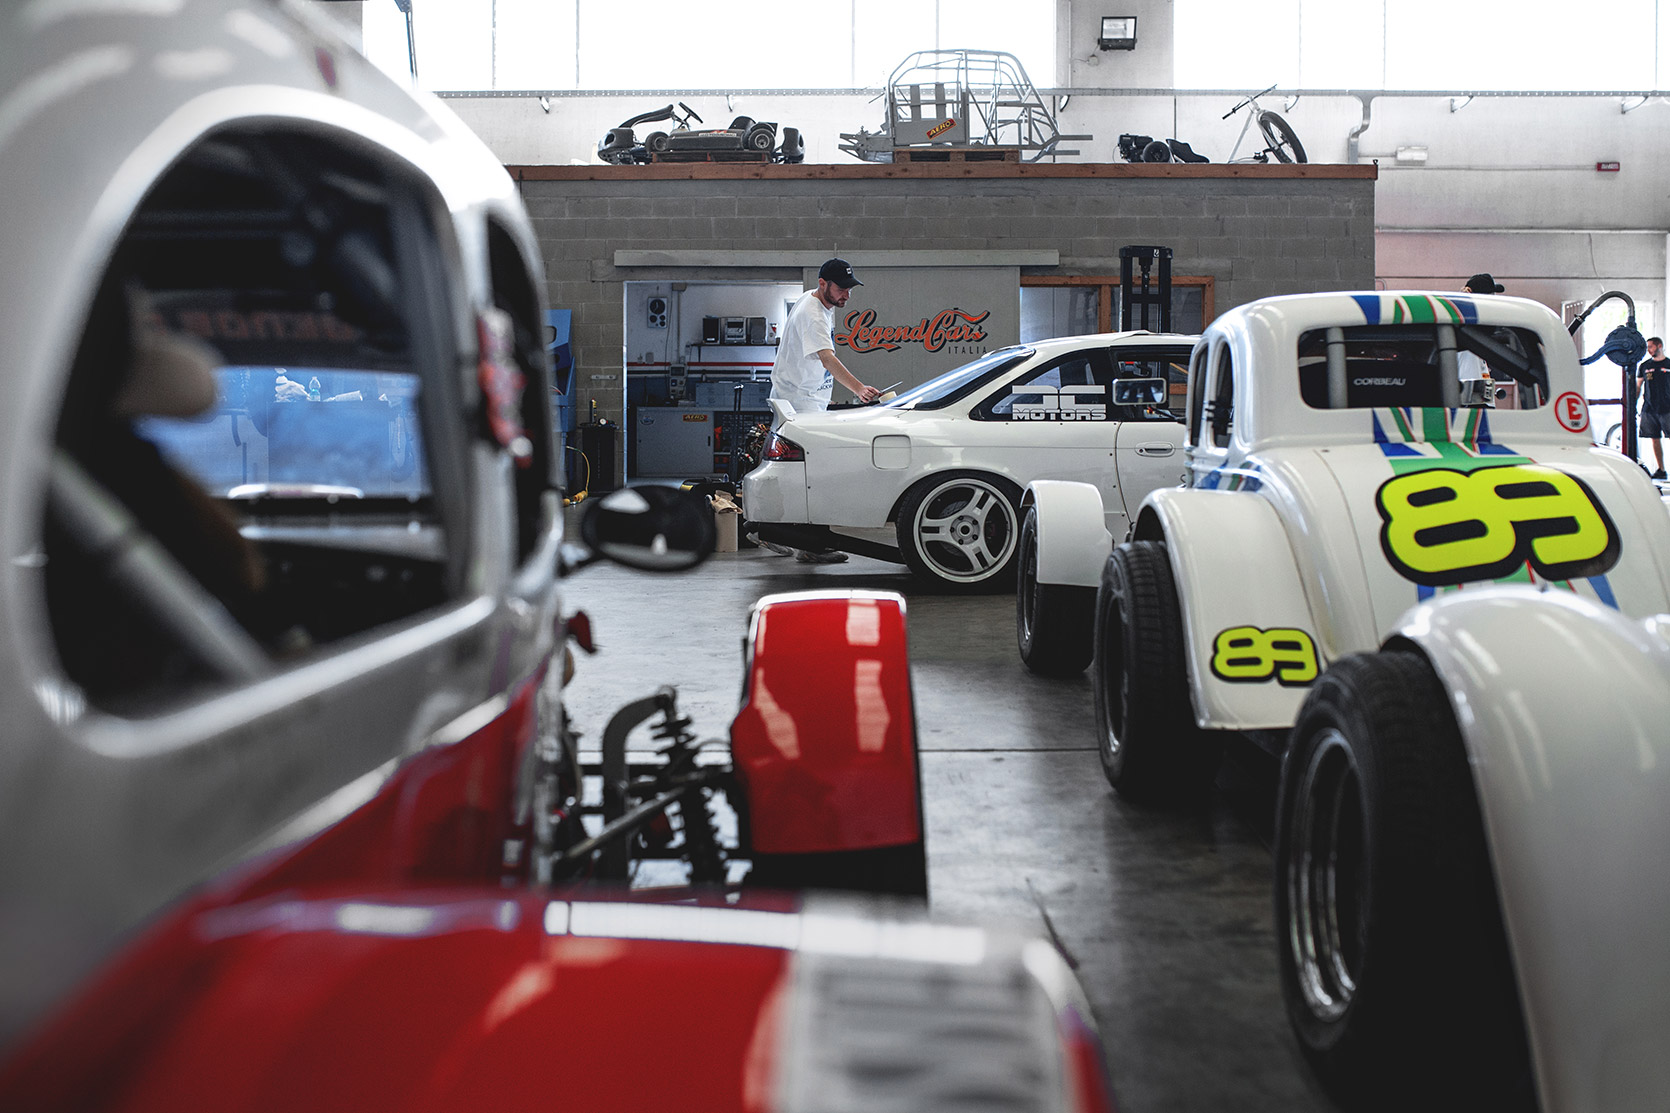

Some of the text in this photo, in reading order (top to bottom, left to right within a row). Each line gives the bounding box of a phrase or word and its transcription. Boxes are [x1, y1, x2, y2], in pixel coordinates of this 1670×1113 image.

[948, 346, 988, 355] ITALIA
[1353, 377, 1407, 386] CORBEAU
[1012, 408, 1107, 420] MOTORS
[1566, 397, 1583, 420] E
[1376, 465, 1620, 585] 89
[1210, 625, 1321, 687] 89
